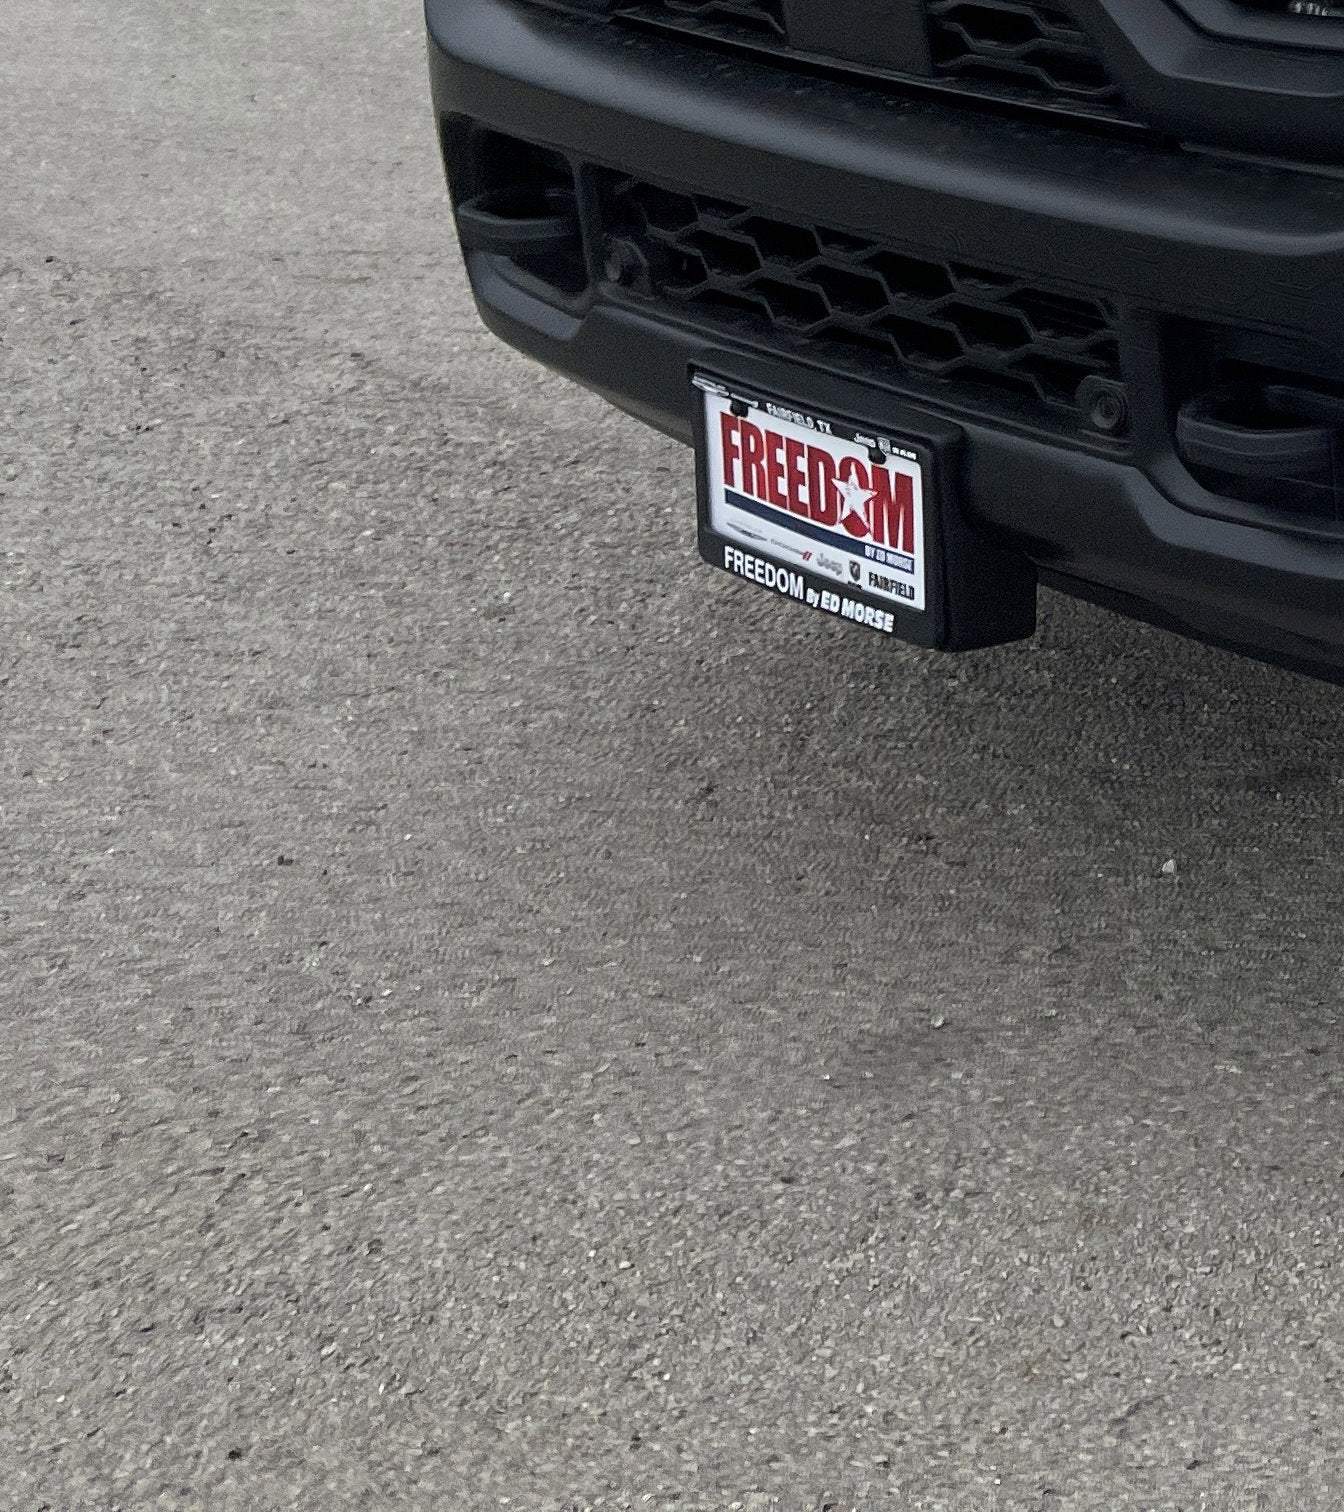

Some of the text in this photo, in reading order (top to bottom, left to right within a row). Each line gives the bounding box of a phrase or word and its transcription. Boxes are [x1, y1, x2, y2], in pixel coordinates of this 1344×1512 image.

[720, 411, 915, 554] FREEDOM
[724, 545, 804, 600] FREEDOM
[821, 590, 841, 613] ED
[841, 597, 895, 633] MORSE
[868, 571, 915, 601] FAIRFIELD
